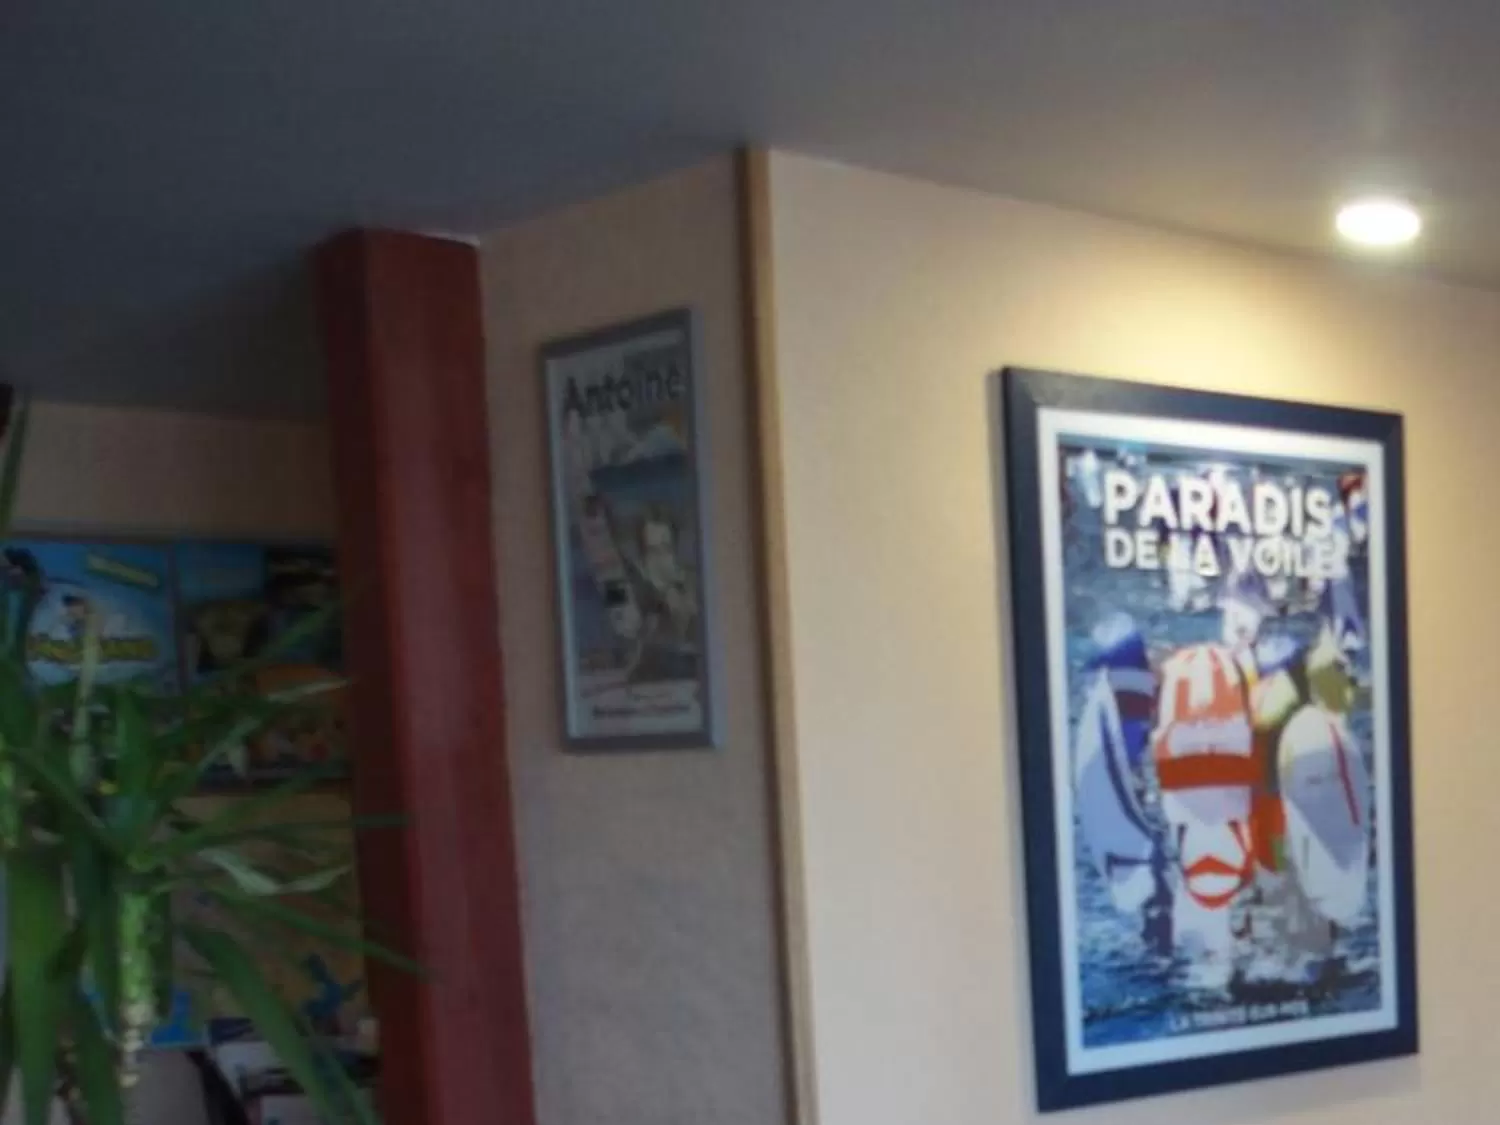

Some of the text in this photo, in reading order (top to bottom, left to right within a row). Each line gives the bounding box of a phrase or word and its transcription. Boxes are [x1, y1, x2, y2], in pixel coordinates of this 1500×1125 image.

[562, 360, 686, 420] Antoine
[1104, 471, 1333, 538] PARADIS
[1106, 528, 1338, 578] DE LA VOILE
